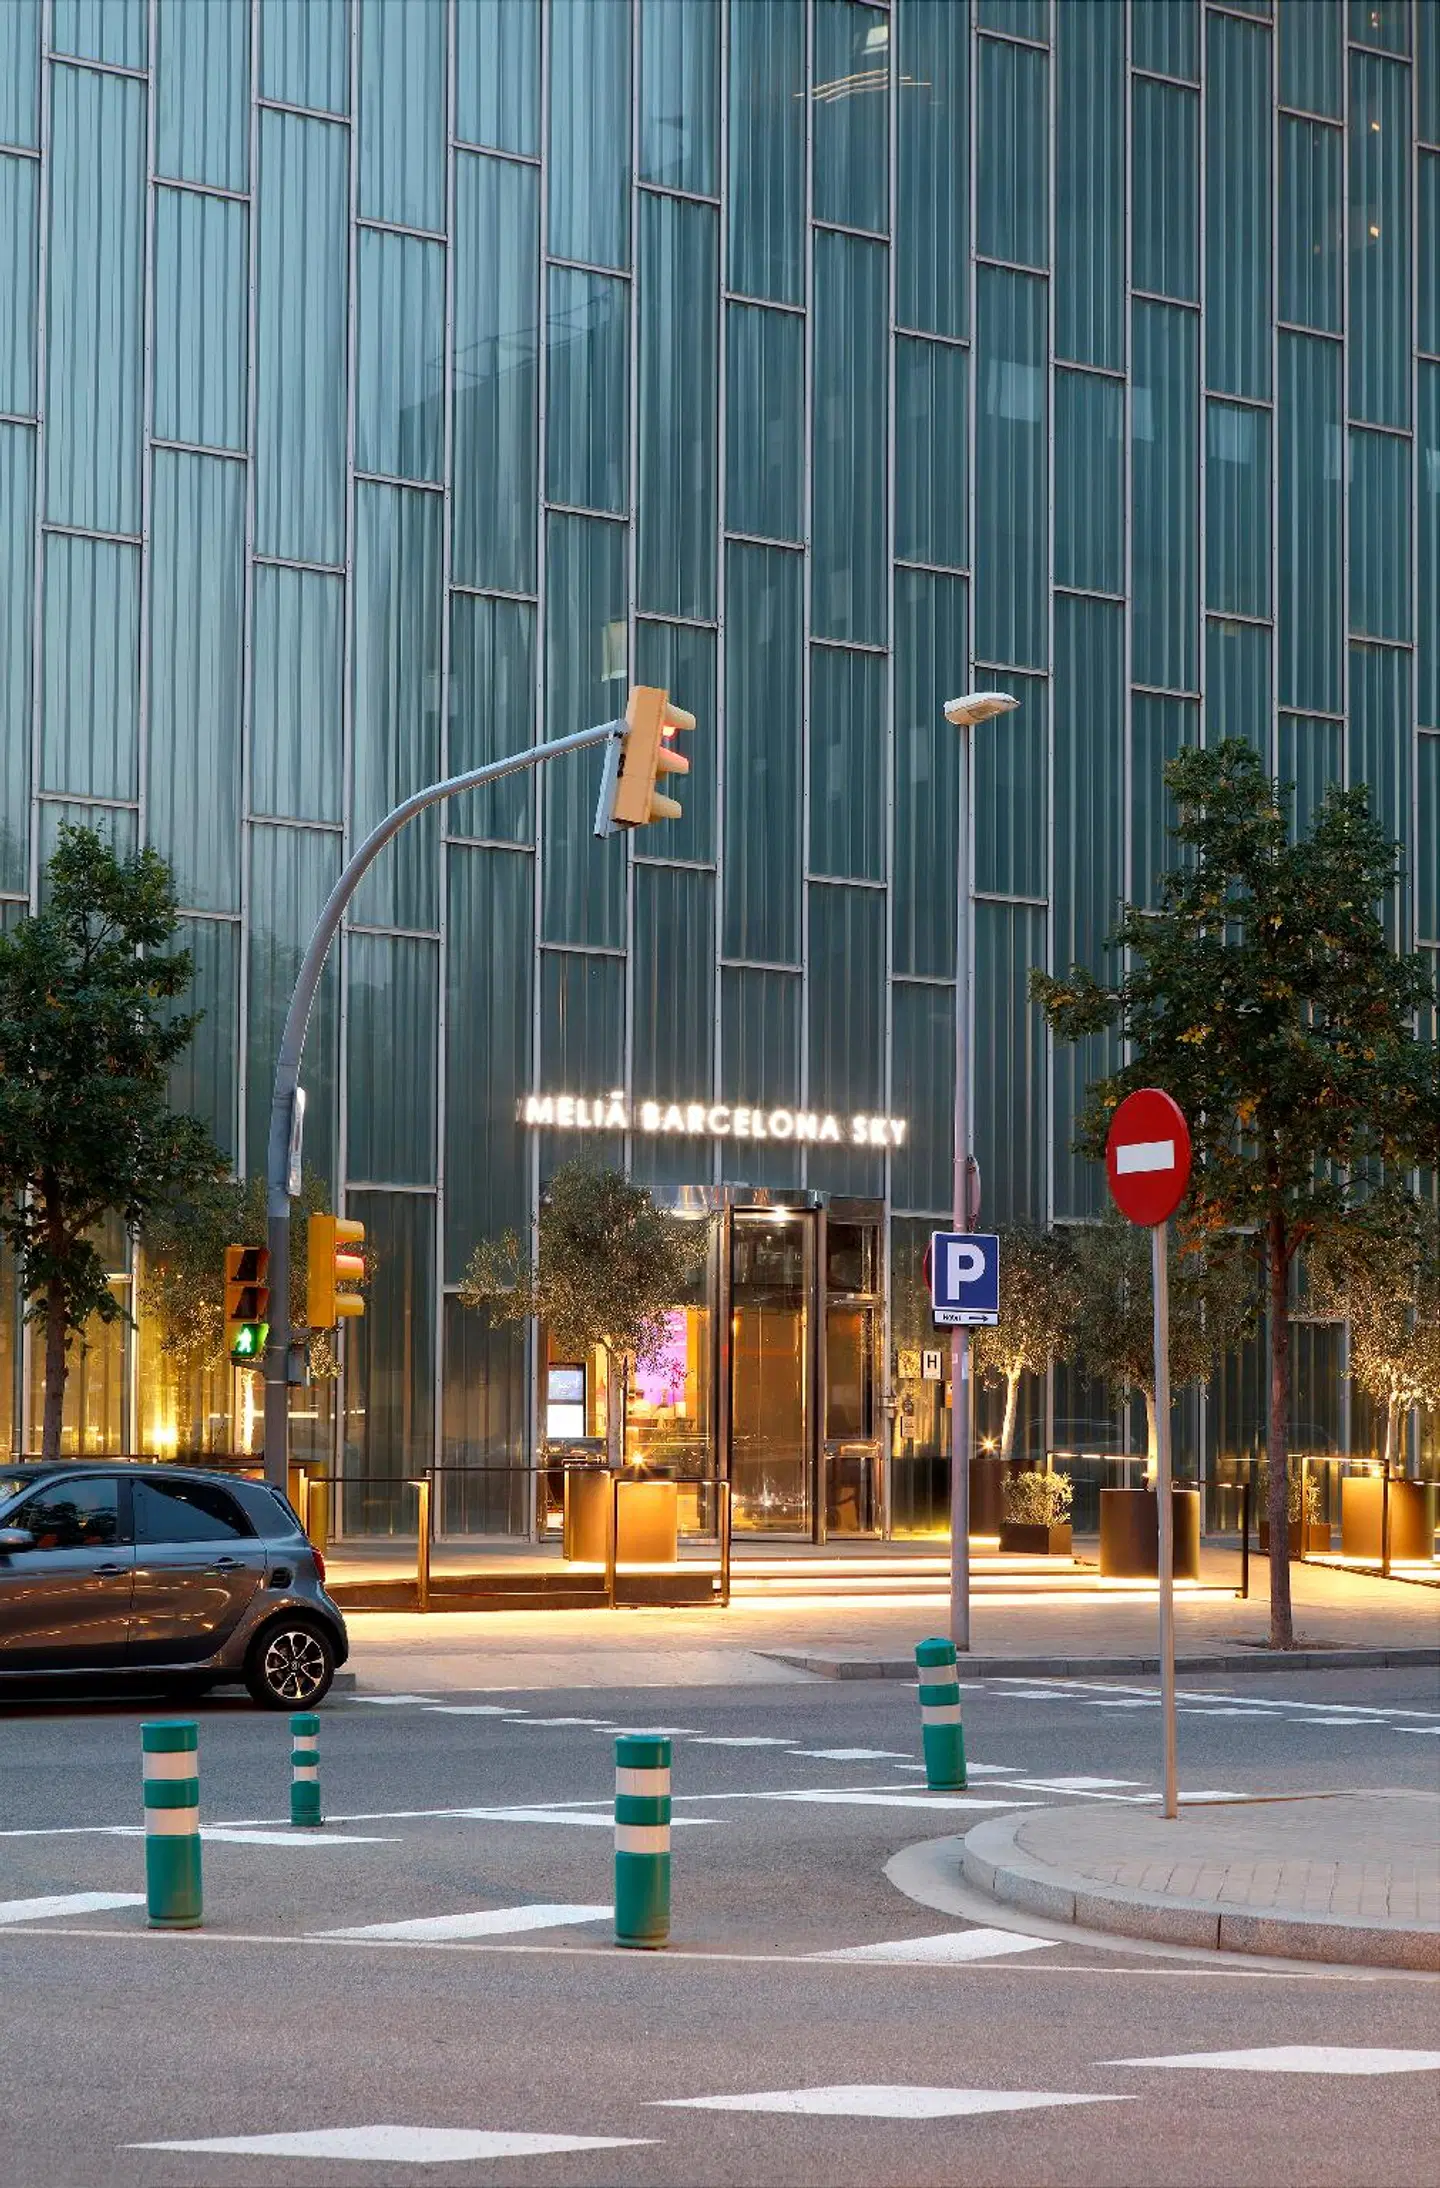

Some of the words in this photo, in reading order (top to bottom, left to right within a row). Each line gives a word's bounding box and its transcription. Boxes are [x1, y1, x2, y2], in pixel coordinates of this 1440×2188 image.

[526, 1091, 628, 1129] MELIÁ
[642, 1101, 840, 1141] BARCELONA
[853, 1115, 906, 1146] SKY
[947, 1242, 986, 1300] P
[927, 1354, 937, 1369] H
